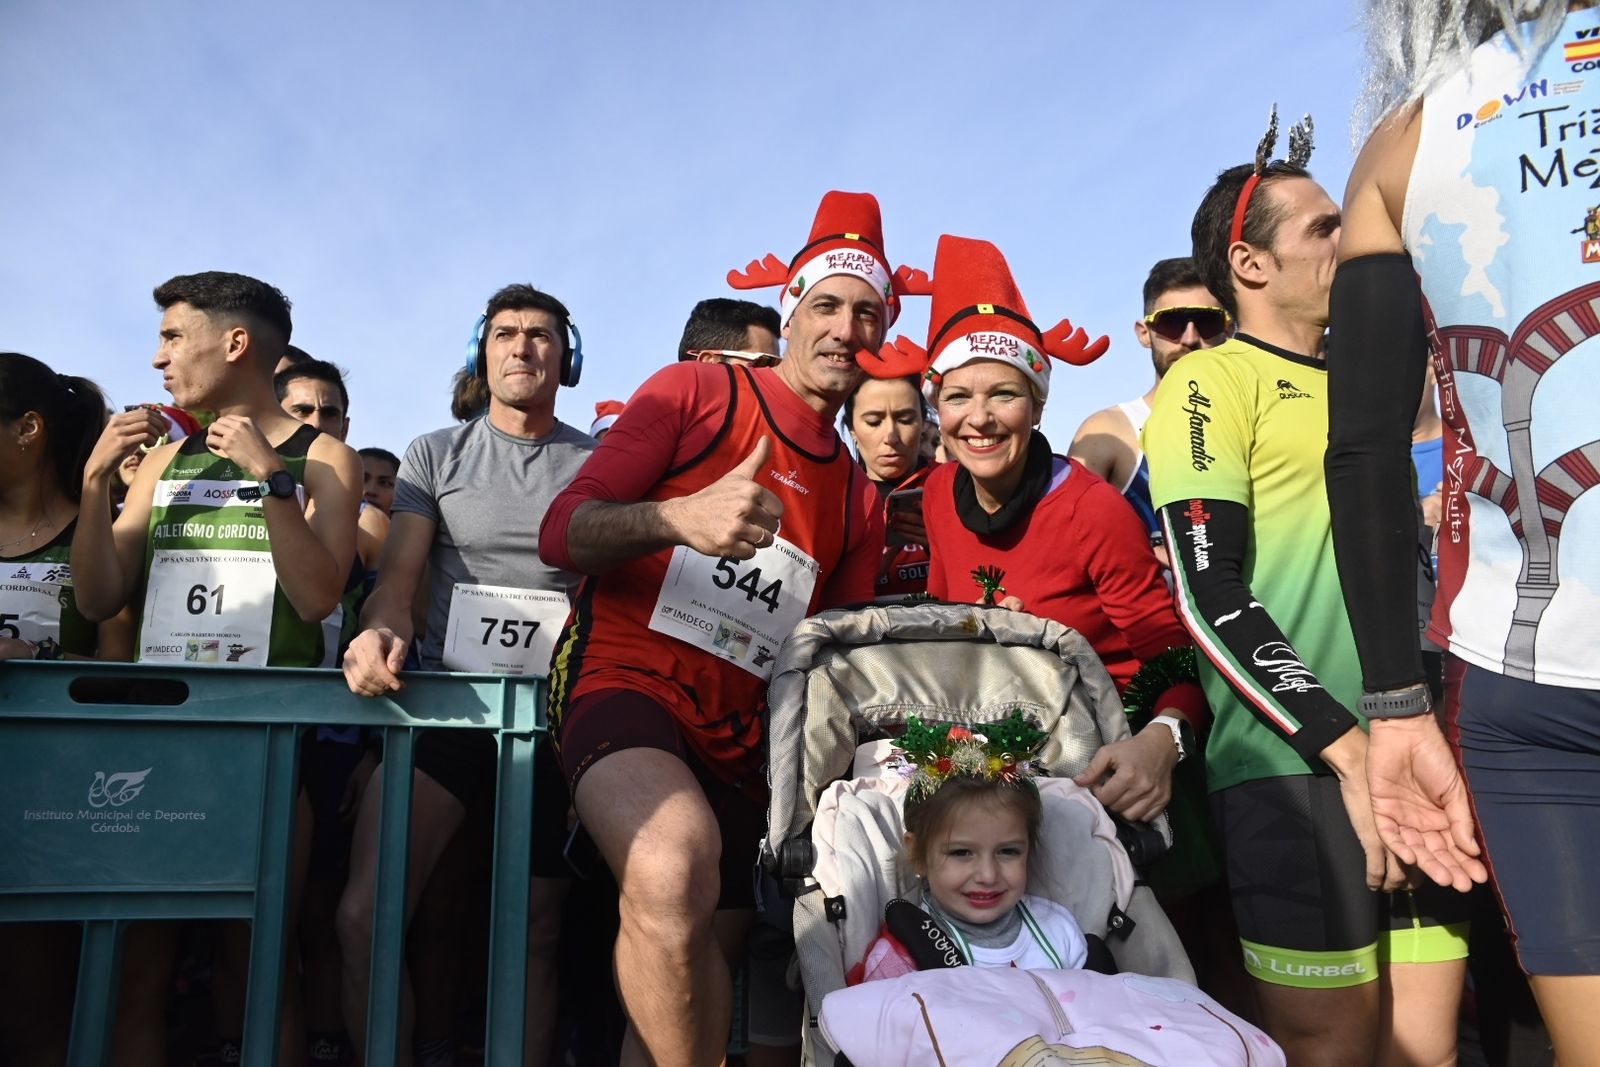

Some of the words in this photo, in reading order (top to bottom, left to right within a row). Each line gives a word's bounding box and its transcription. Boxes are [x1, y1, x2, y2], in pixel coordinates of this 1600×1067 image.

[1457, 78, 1547, 130] DOWN
[825, 252, 874, 266] MERRY
[966, 333, 1018, 348] MERRY
[770, 470, 809, 495] TEAMERGY
[1446, 427, 1474, 544] Mezquita
[155, 523, 214, 539] ATLETISMO
[712, 555, 783, 614] 544
[187, 584, 224, 615] 61
[691, 599, 707, 609] JUAN
[708, 607, 734, 621] ANTONIO
[673, 609, 714, 632] IMDECO
[481, 617, 540, 648] 757
[153, 645, 182, 653] IMDECO
[24, 810, 73, 820] Instituto
[77, 810, 133, 822] Municipal
[137, 810, 151, 820] de
[155, 810, 207, 822] Deportes
[91, 822, 140, 833] Córdoba
[922, 920, 961, 966] JOGG
